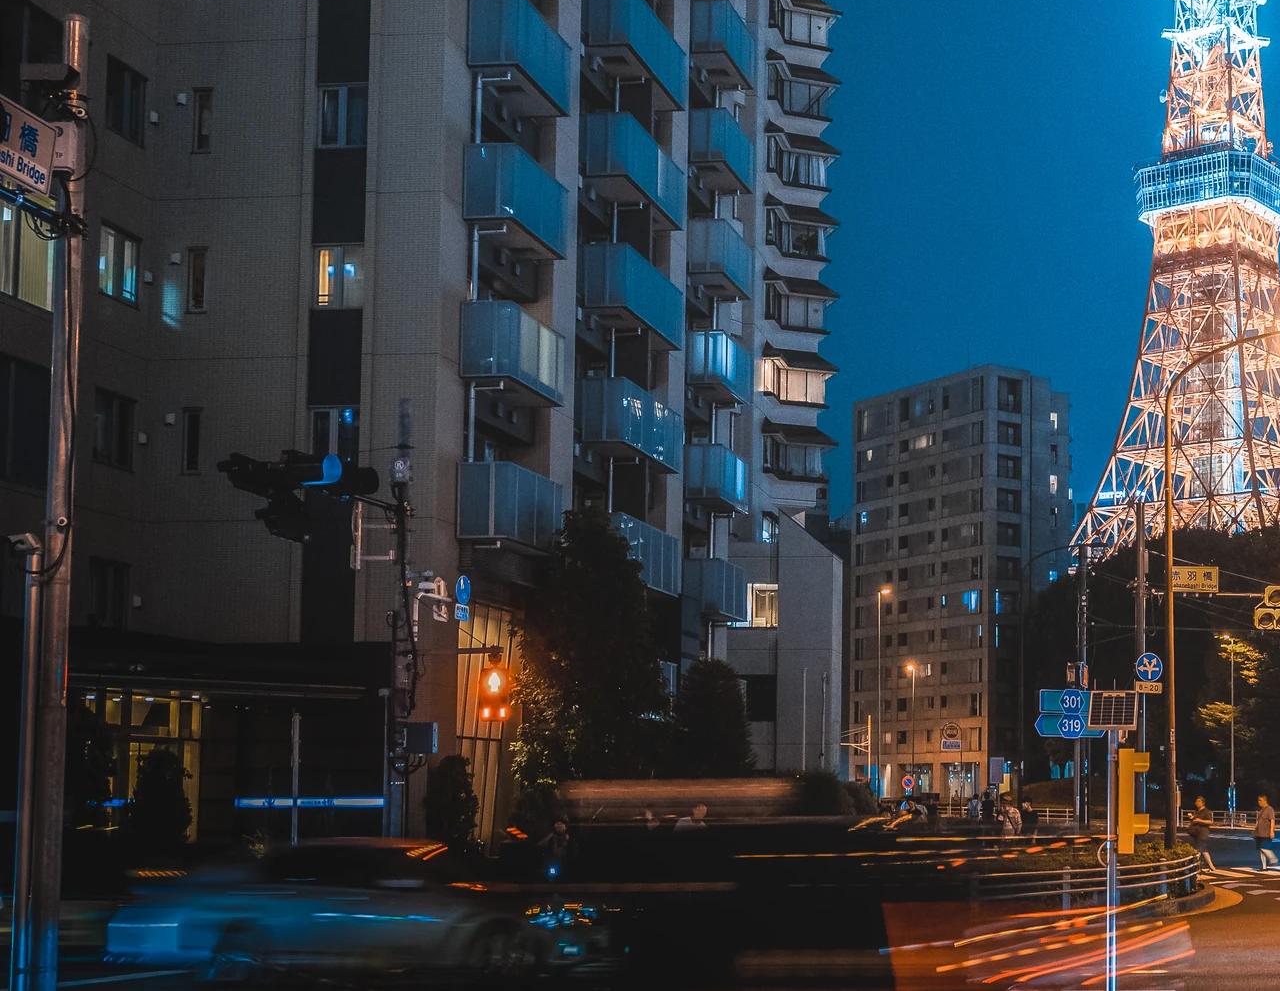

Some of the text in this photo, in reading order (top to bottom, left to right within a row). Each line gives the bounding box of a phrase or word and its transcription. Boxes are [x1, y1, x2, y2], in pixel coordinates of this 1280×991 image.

[16, 155, 46, 185] Bridge
[1063, 695, 1081, 709] 301
[1061, 719, 1081, 732] 319
